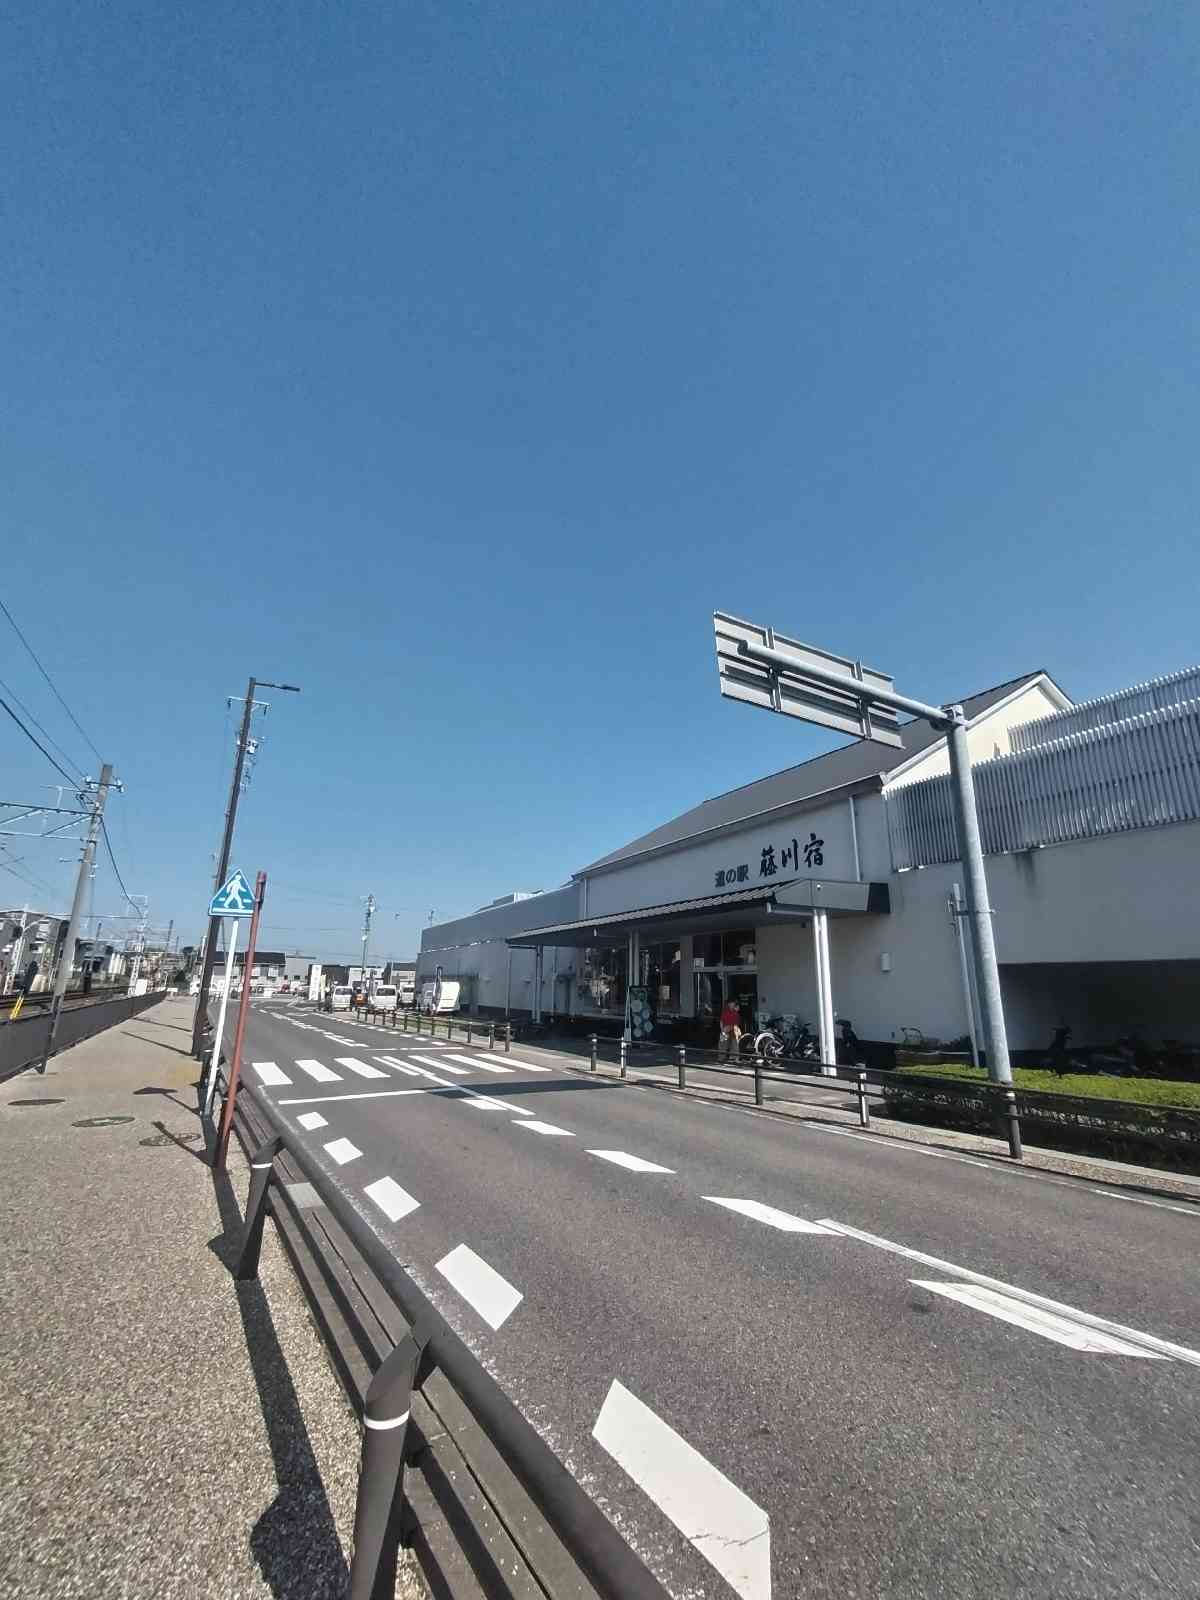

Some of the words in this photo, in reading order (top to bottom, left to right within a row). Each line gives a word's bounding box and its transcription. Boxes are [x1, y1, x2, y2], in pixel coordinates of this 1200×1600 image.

[714, 864, 749, 887] 道の駅
[759, 833, 825, 877] 藤川宿
